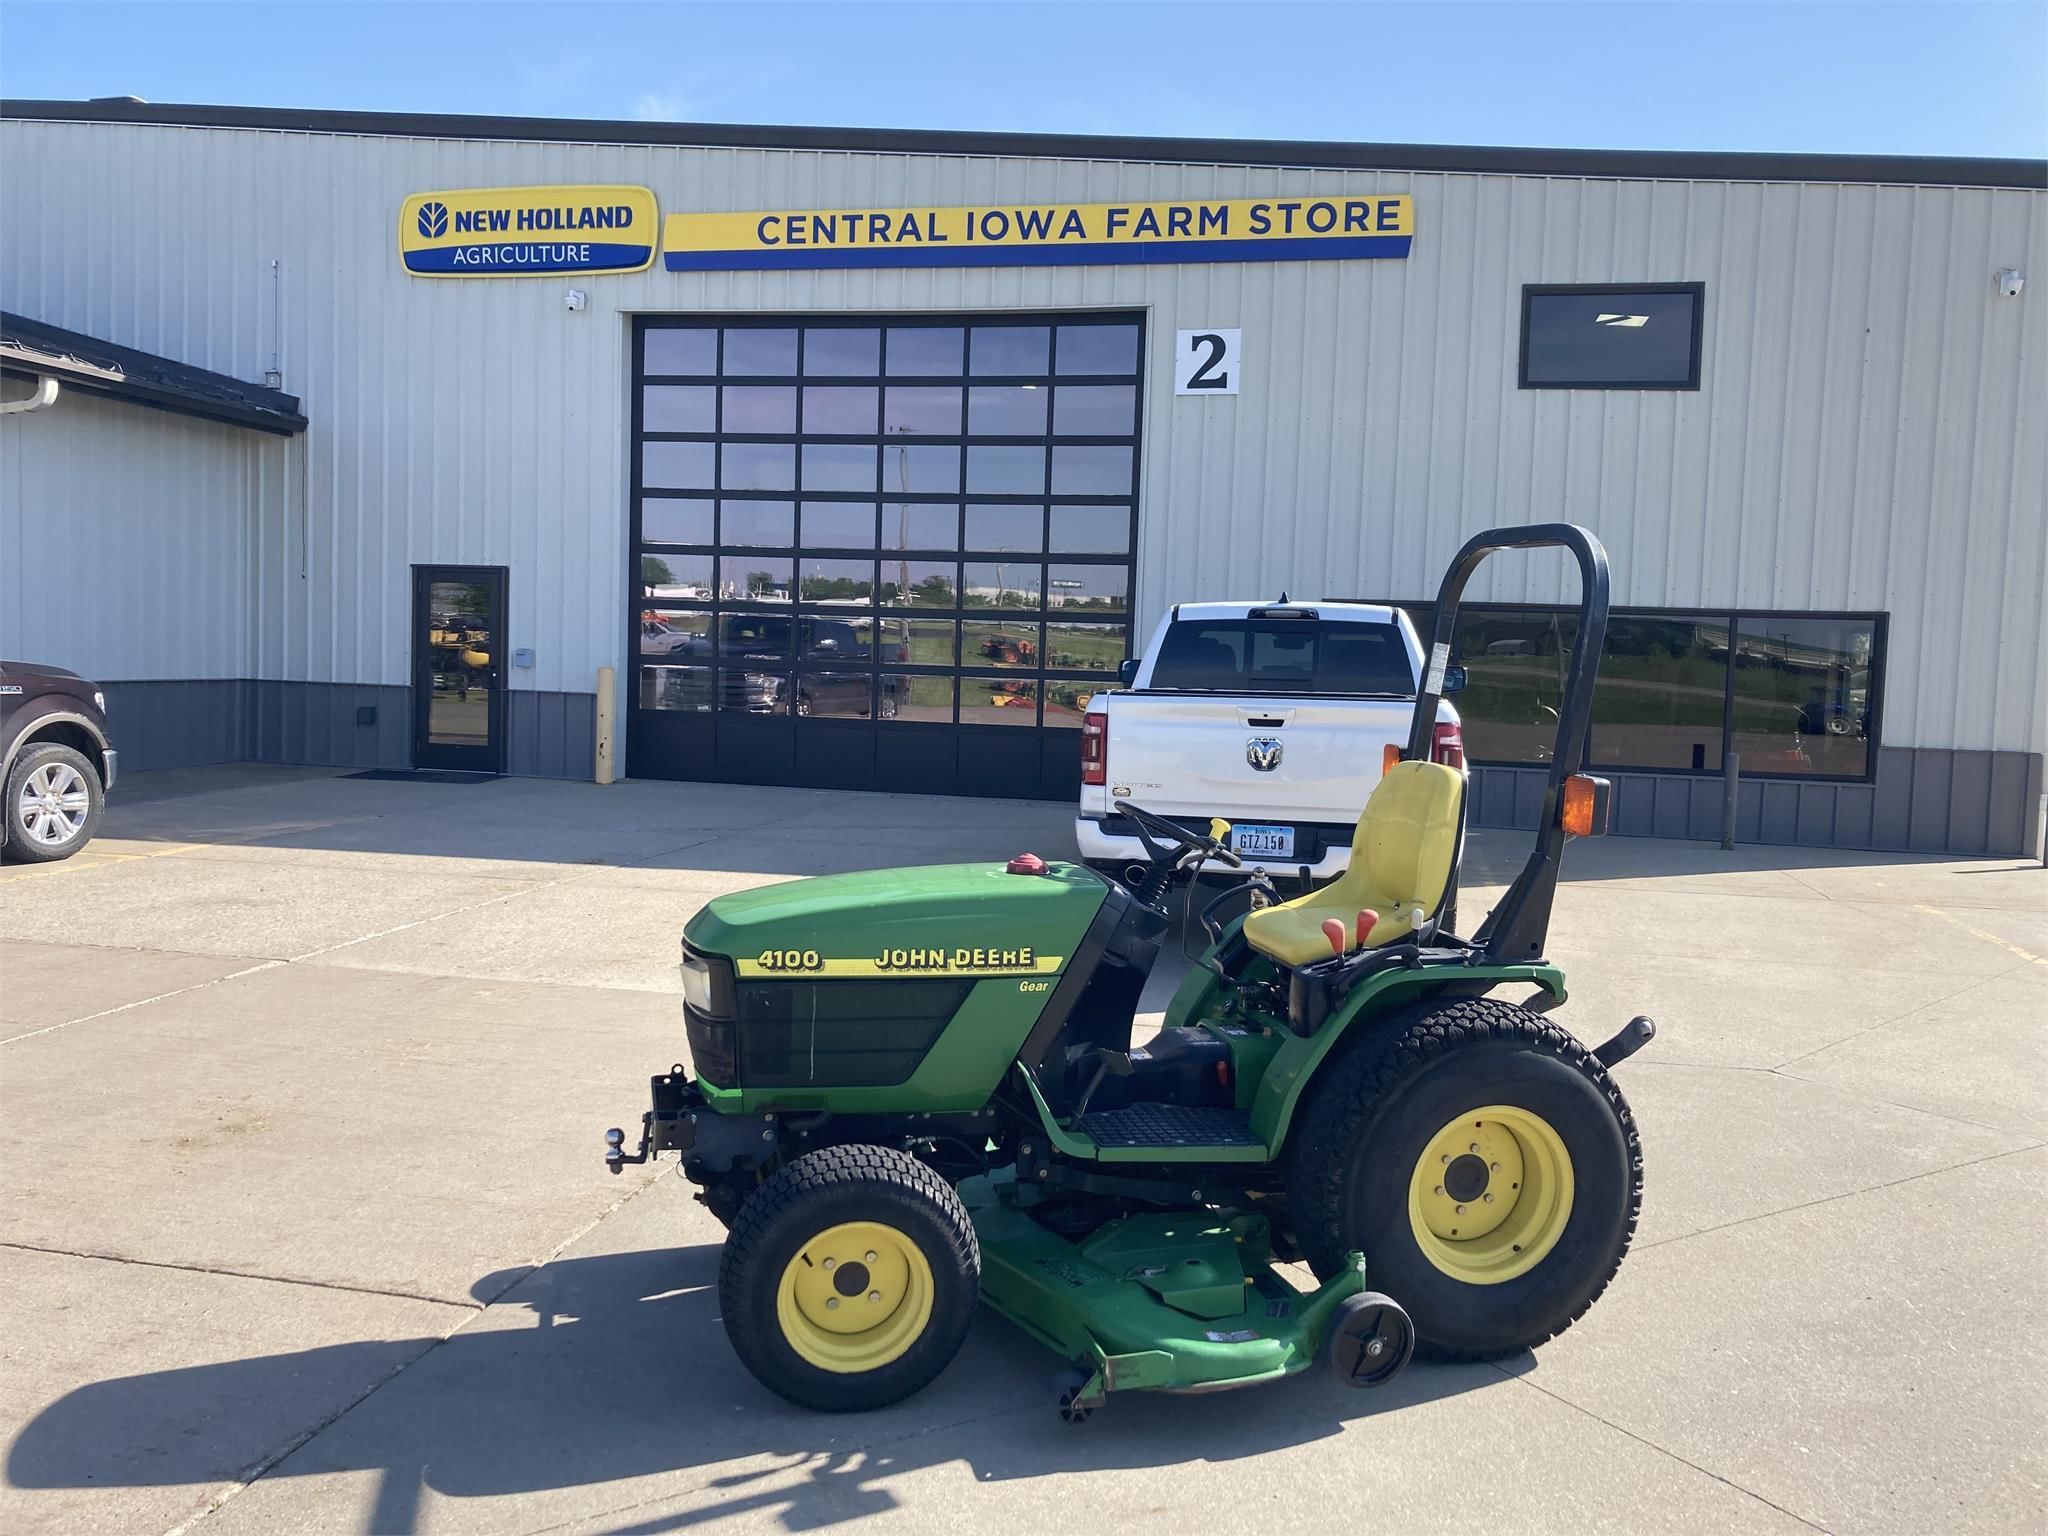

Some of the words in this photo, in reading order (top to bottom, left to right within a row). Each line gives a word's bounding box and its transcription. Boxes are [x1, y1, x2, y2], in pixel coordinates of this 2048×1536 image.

[455, 210, 511, 232] NEW
[517, 206, 633, 231] HOLLAND
[757, 212, 948, 245] CENTRAL
[966, 209, 1087, 241] IOWA
[1106, 205, 1229, 238] FARM
[1249, 200, 1401, 235] STORE
[453, 245, 590, 265] AGRICULTURE
[1186, 333, 1228, 389] 2
[1240, 834, 1260, 849] GTZ
[1264, 835, 1284, 850] 150
[758, 949, 823, 970] 4100
[874, 948, 949, 968] JOHN
[954, 947, 1035, 967] DEERE
[1018, 980, 1049, 993] Gear
